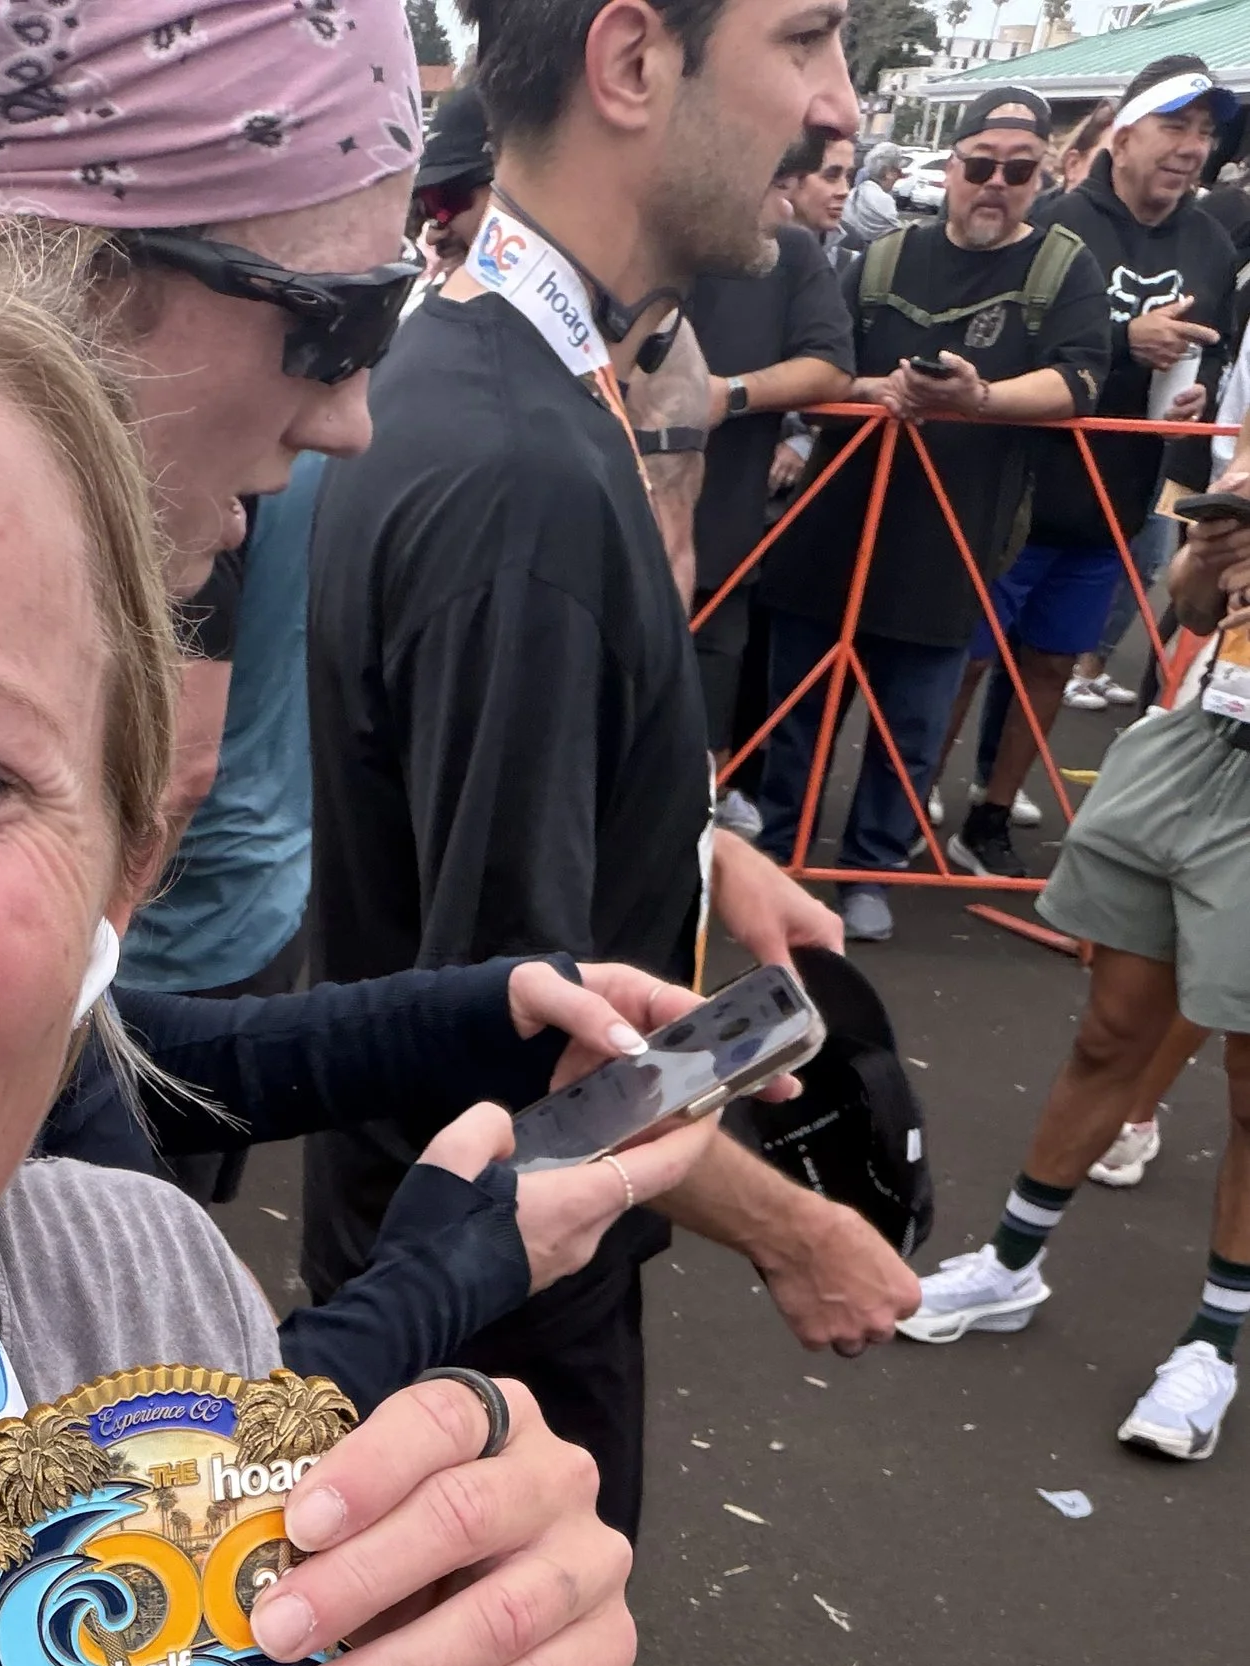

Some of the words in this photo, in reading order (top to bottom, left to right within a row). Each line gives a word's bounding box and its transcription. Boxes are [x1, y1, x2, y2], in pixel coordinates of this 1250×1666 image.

[98, 1401, 188, 1439] Experience
[188, 1397, 223, 1423] OC
[147, 1457, 201, 1490] THE
